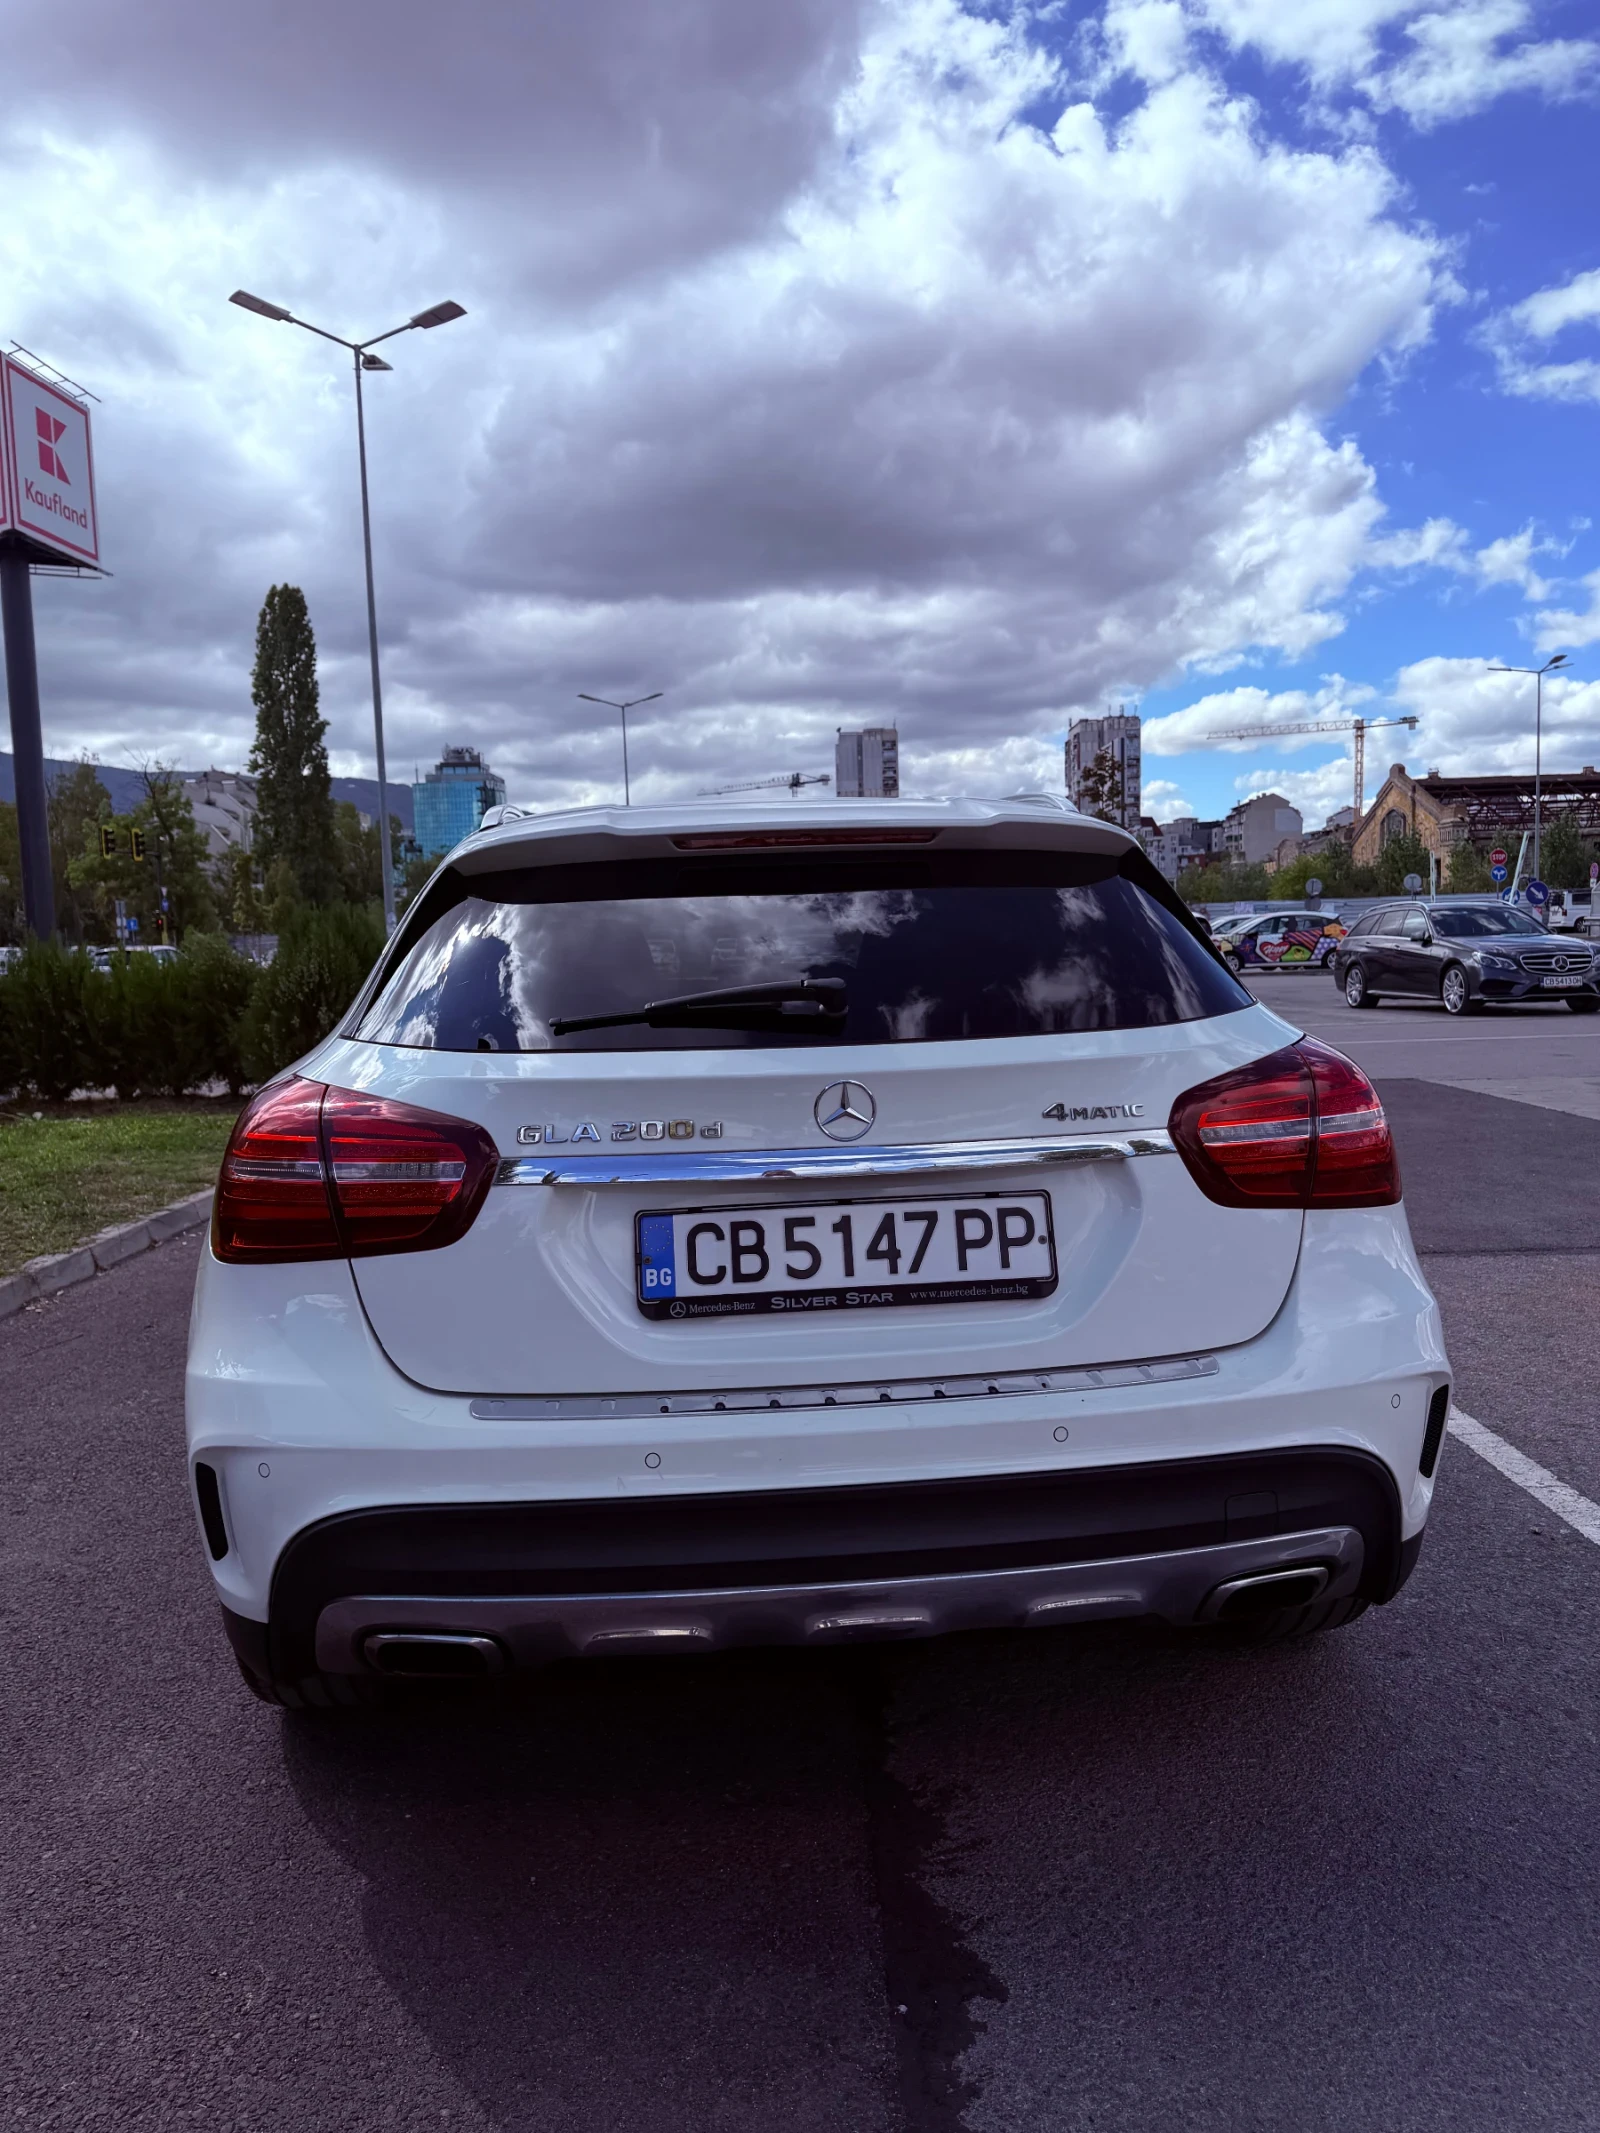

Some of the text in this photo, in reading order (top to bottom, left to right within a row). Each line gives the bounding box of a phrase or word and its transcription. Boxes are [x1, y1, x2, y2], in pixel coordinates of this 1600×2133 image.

[24, 477, 88, 530] Kaufland
[1491, 853, 1506, 861] STOP
[1042, 1102, 1145, 1121] 4MATIC
[517, 1123, 601, 1145] GLA
[645, 1267, 672, 1287] BG
[770, 1292, 894, 1309] SILVER STAR
[909, 1284, 1029, 1300] www.mercedes-benz.bg
[689, 1302, 756, 1314] Mercedes-Benz
